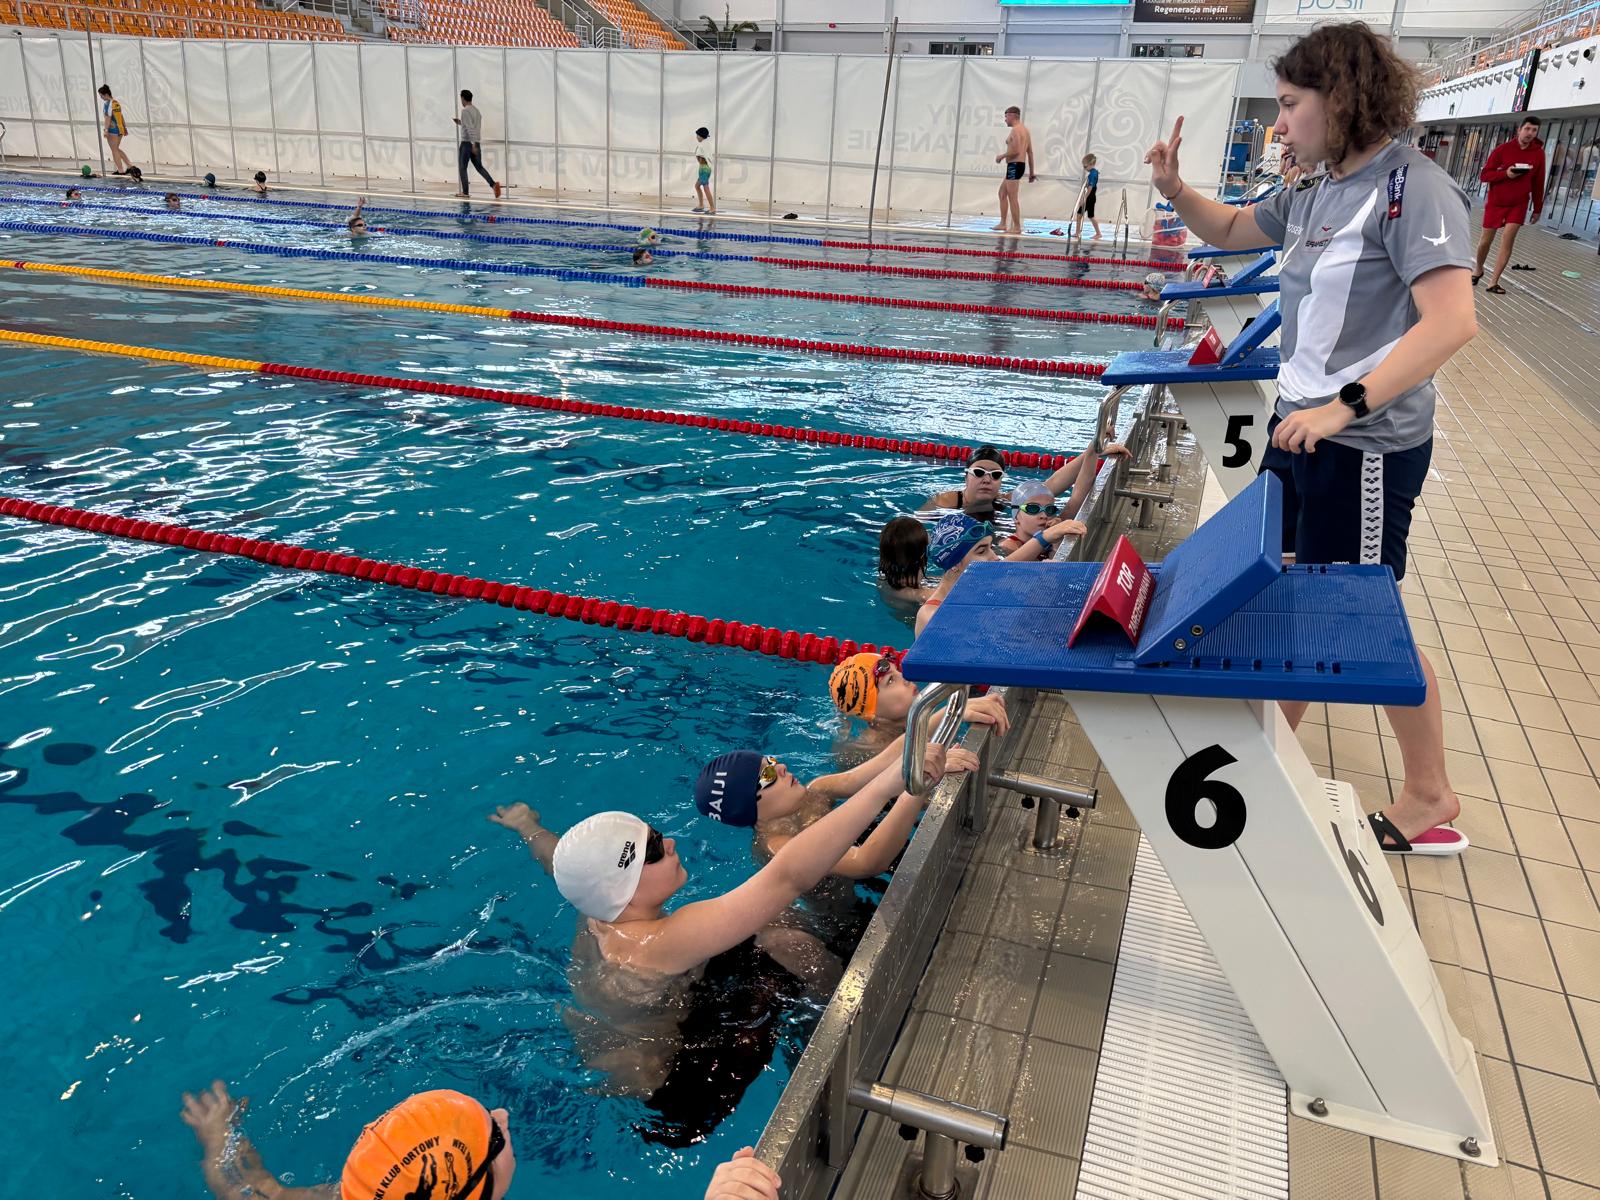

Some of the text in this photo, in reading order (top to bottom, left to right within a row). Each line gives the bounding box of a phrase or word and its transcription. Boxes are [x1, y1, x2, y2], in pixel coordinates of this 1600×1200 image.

[1154, 5, 1201, 15] Regeneracja
[1222, 414, 1254, 469] 5
[1116, 561, 1136, 597] TOR
[1165, 743, 1247, 850] 6
[617, 840, 631, 868] arena
[1329, 820, 1385, 927] 6
[380, 1164, 401, 1189] KLUB
[400, 1135, 440, 1168] ORTOWY
